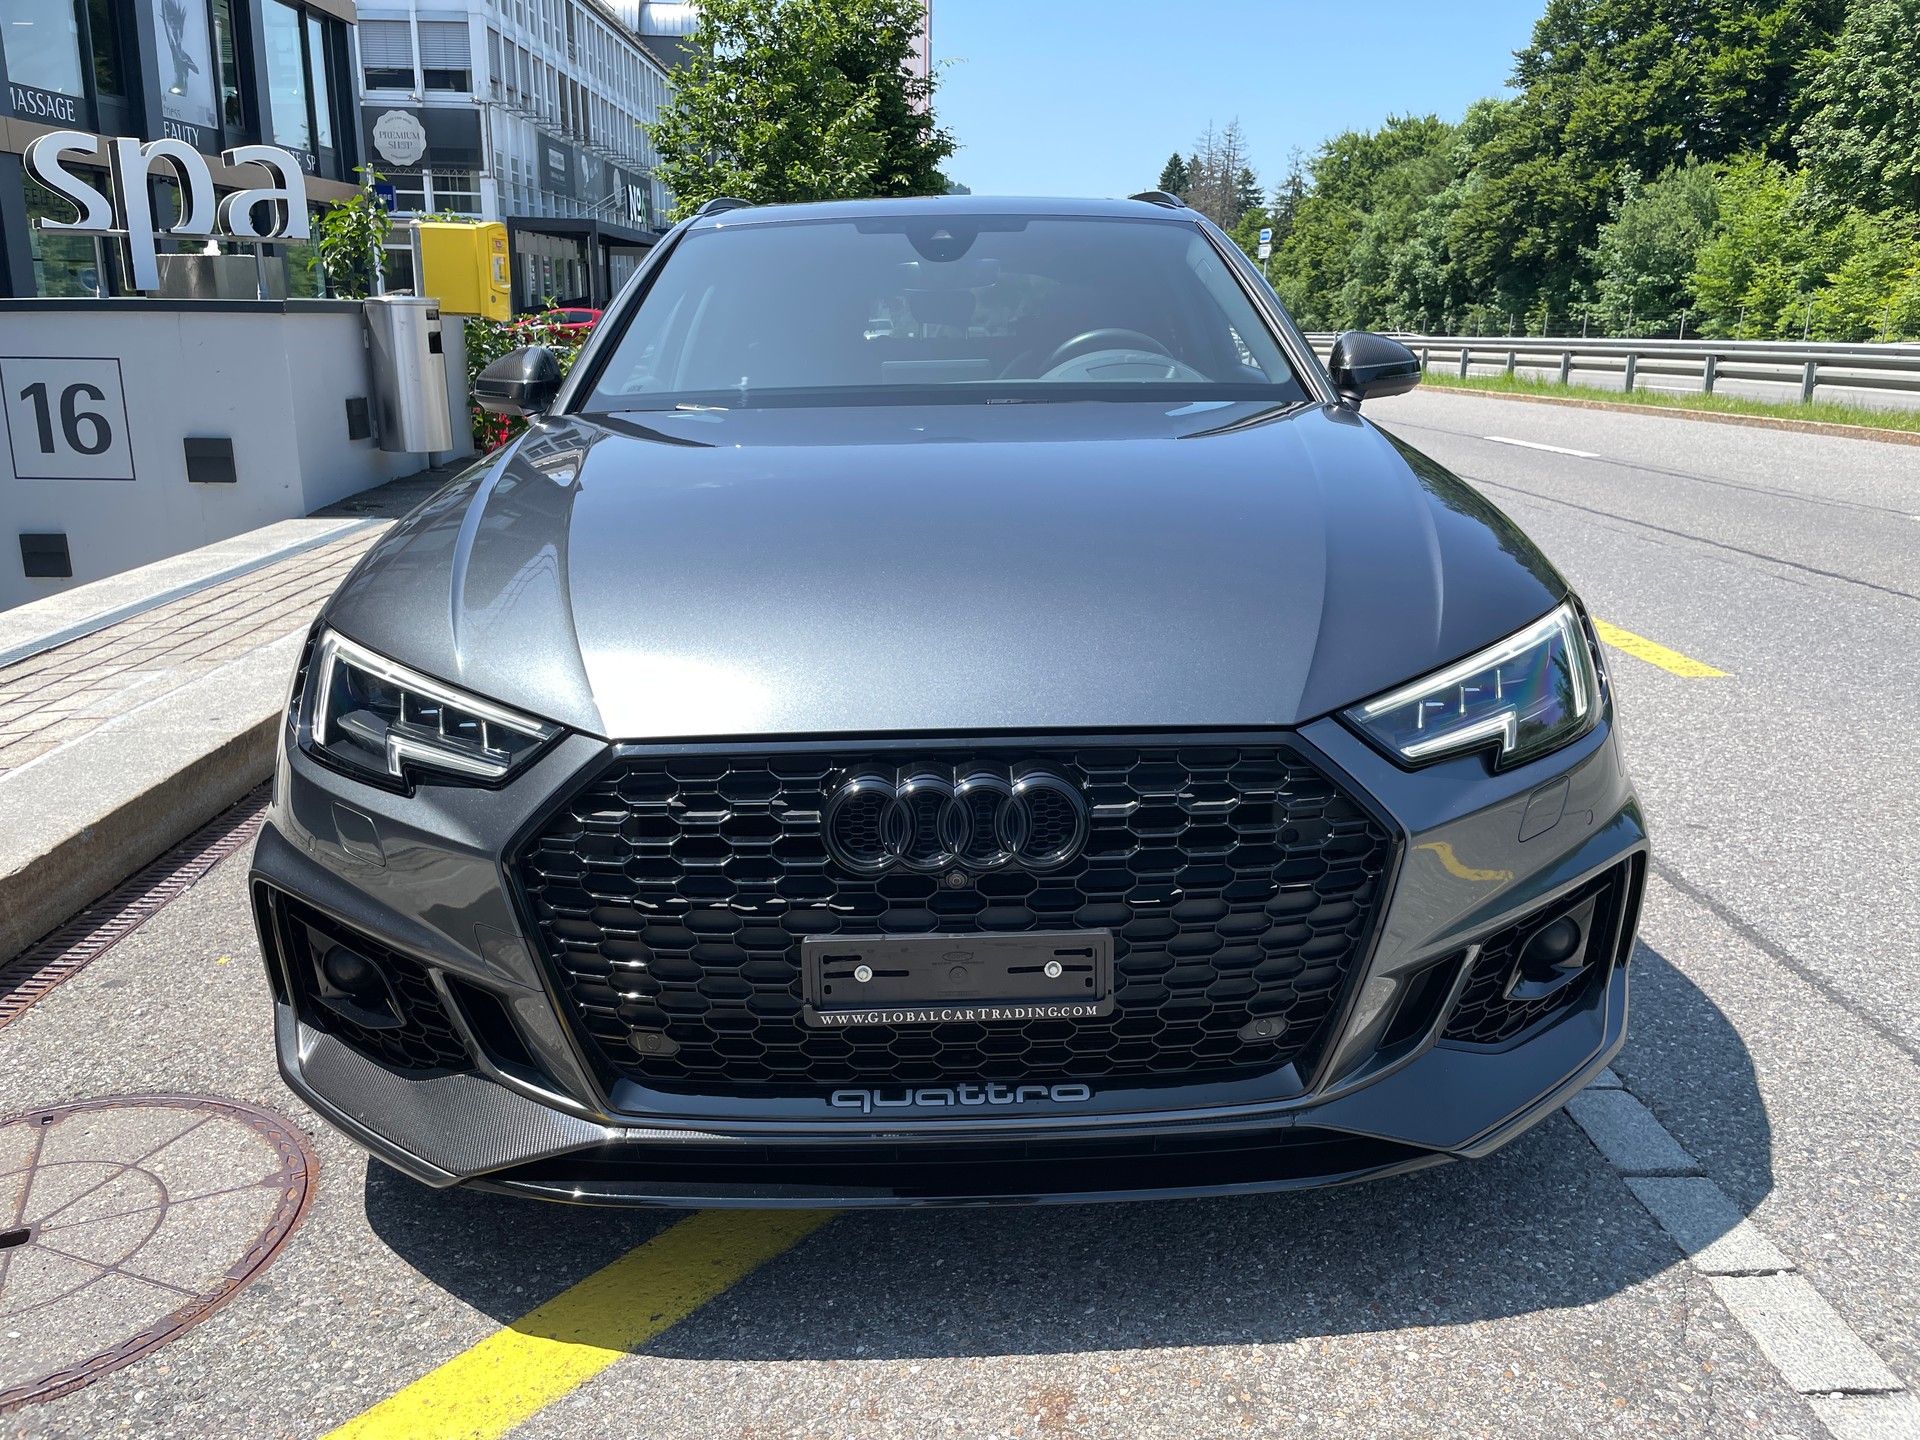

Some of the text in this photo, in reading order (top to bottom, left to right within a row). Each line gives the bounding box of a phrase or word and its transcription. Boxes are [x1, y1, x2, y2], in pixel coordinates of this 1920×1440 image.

[379, 131, 420, 140] PREMIUM
[24, 130, 310, 290] spa
[20, 382, 112, 455] 16
[831, 1082, 1091, 1113] quattro
